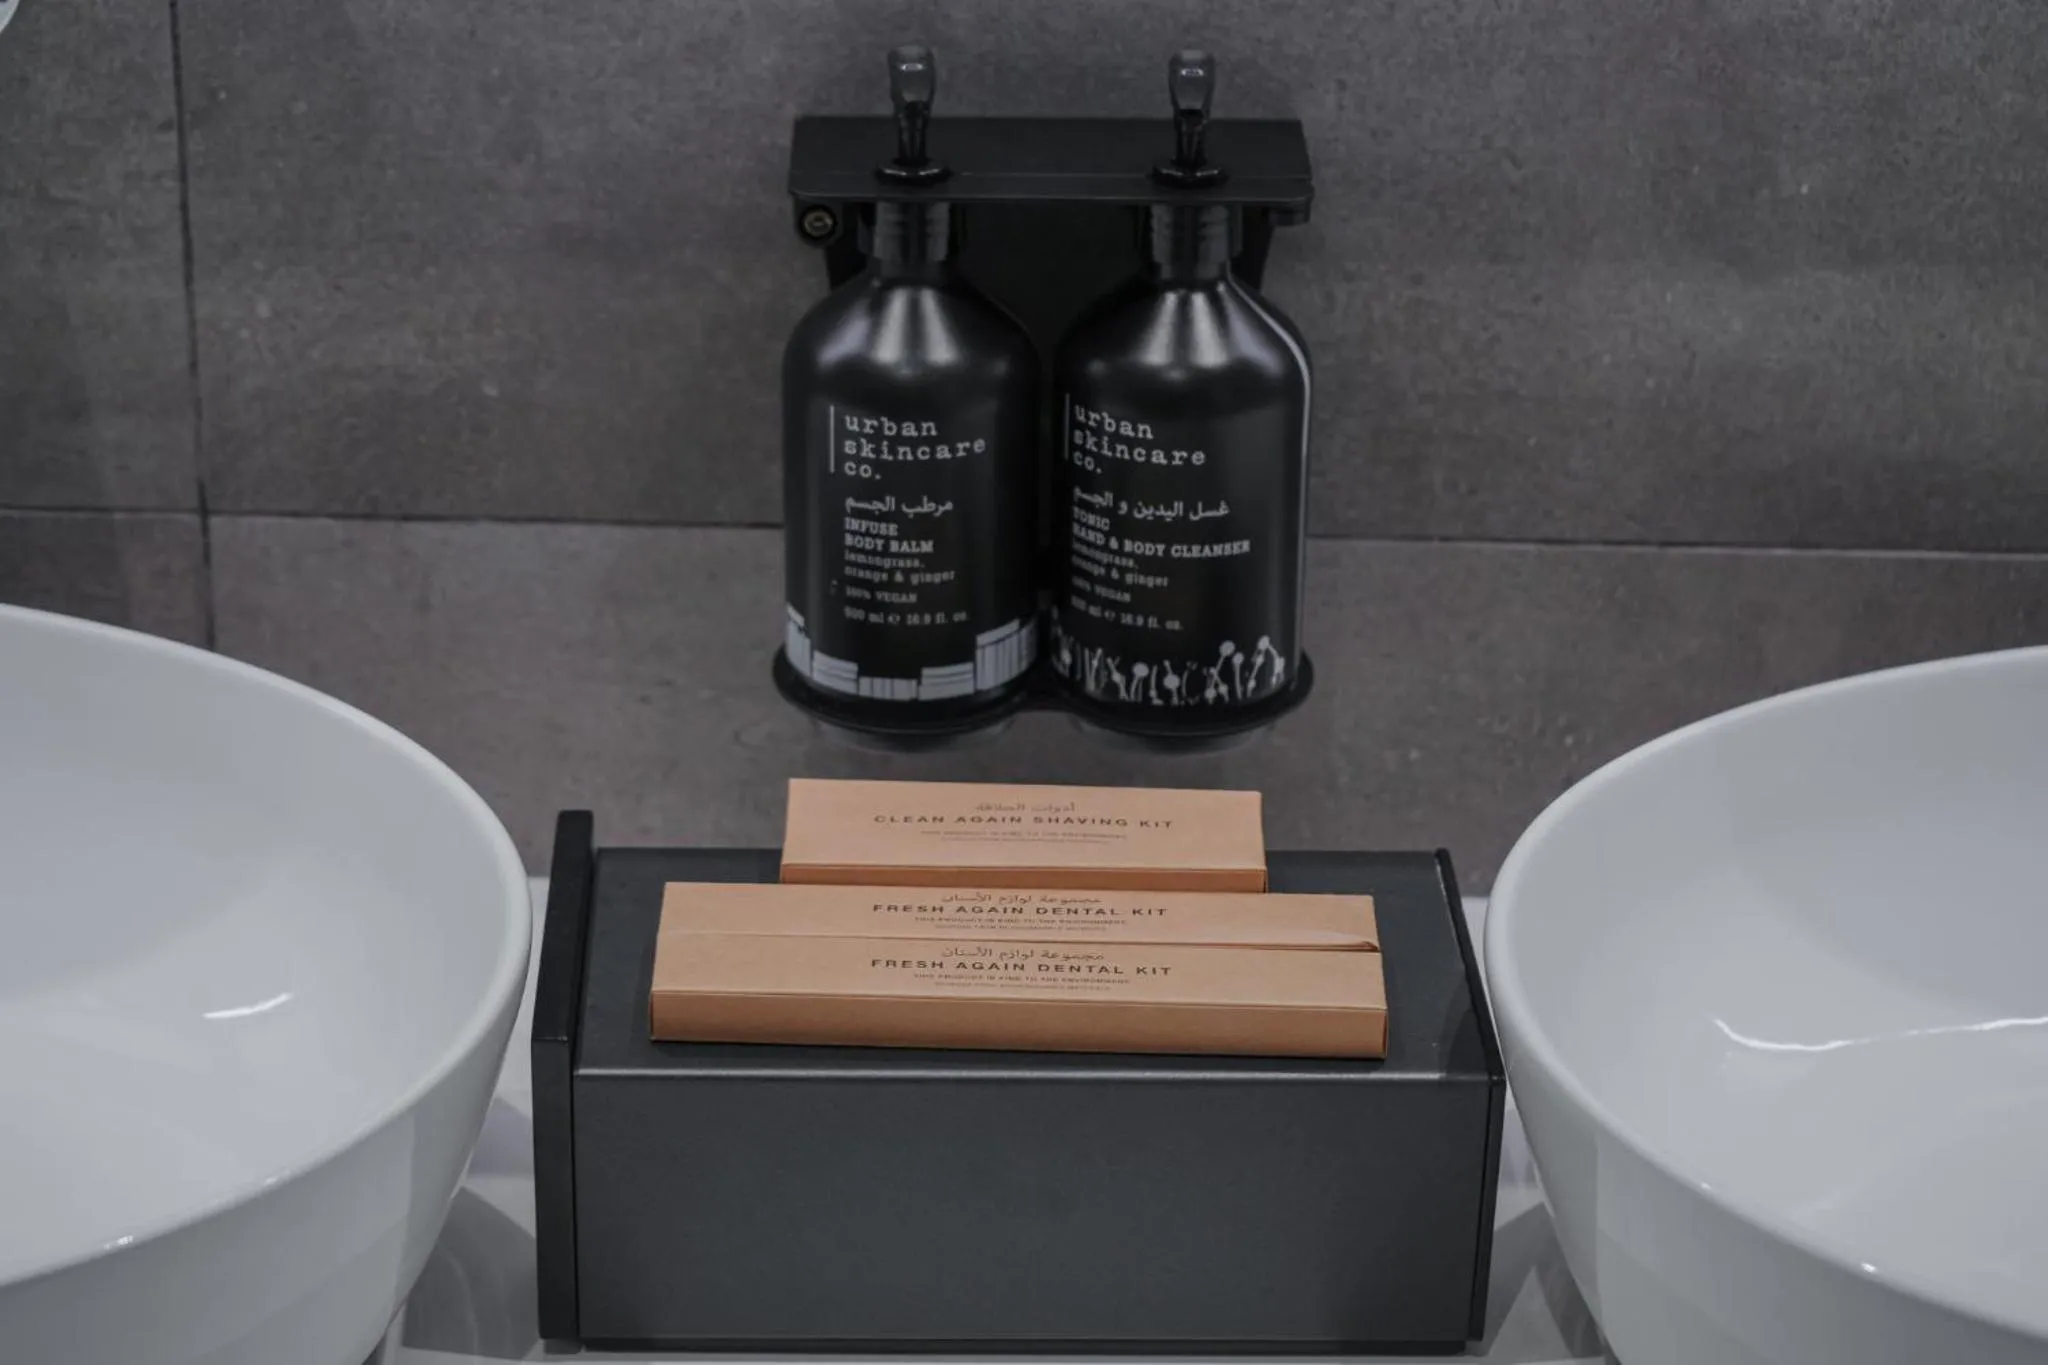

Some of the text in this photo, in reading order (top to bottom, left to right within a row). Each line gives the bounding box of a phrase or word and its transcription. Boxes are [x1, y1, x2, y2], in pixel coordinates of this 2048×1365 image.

[845, 415, 938, 436] urban
[1074, 405, 1153, 439] urban
[844, 438, 986, 461] skincare
[1073, 429, 1206, 466] skincare
[844, 461, 881, 480] co.
[1073, 451, 1102, 474] co.
[845, 495, 953, 518] مرطب الجسم
[1118, 501, 1128, 515] و
[1133, 501, 1183, 522] اليدين
[1189, 500, 1231, 521] غسل
[844, 517, 898, 536] INFUSE
[1073, 506, 1110, 531] TONIC
[844, 532, 934, 553] BODY BALM
[1109, 536, 1119, 550] &
[1123, 538, 1166, 557] BODY
[1171, 540, 1251, 558] CLEANSER
[910, 570, 956, 586] ginger
[873, 815, 1173, 829] CLEAN AGAIN SHAVING KIT
[873, 904, 1169, 917] FRESH AGAIN DENTAL KIT
[871, 959, 1173, 976] FRESH AGAIN DENTAL KIT
